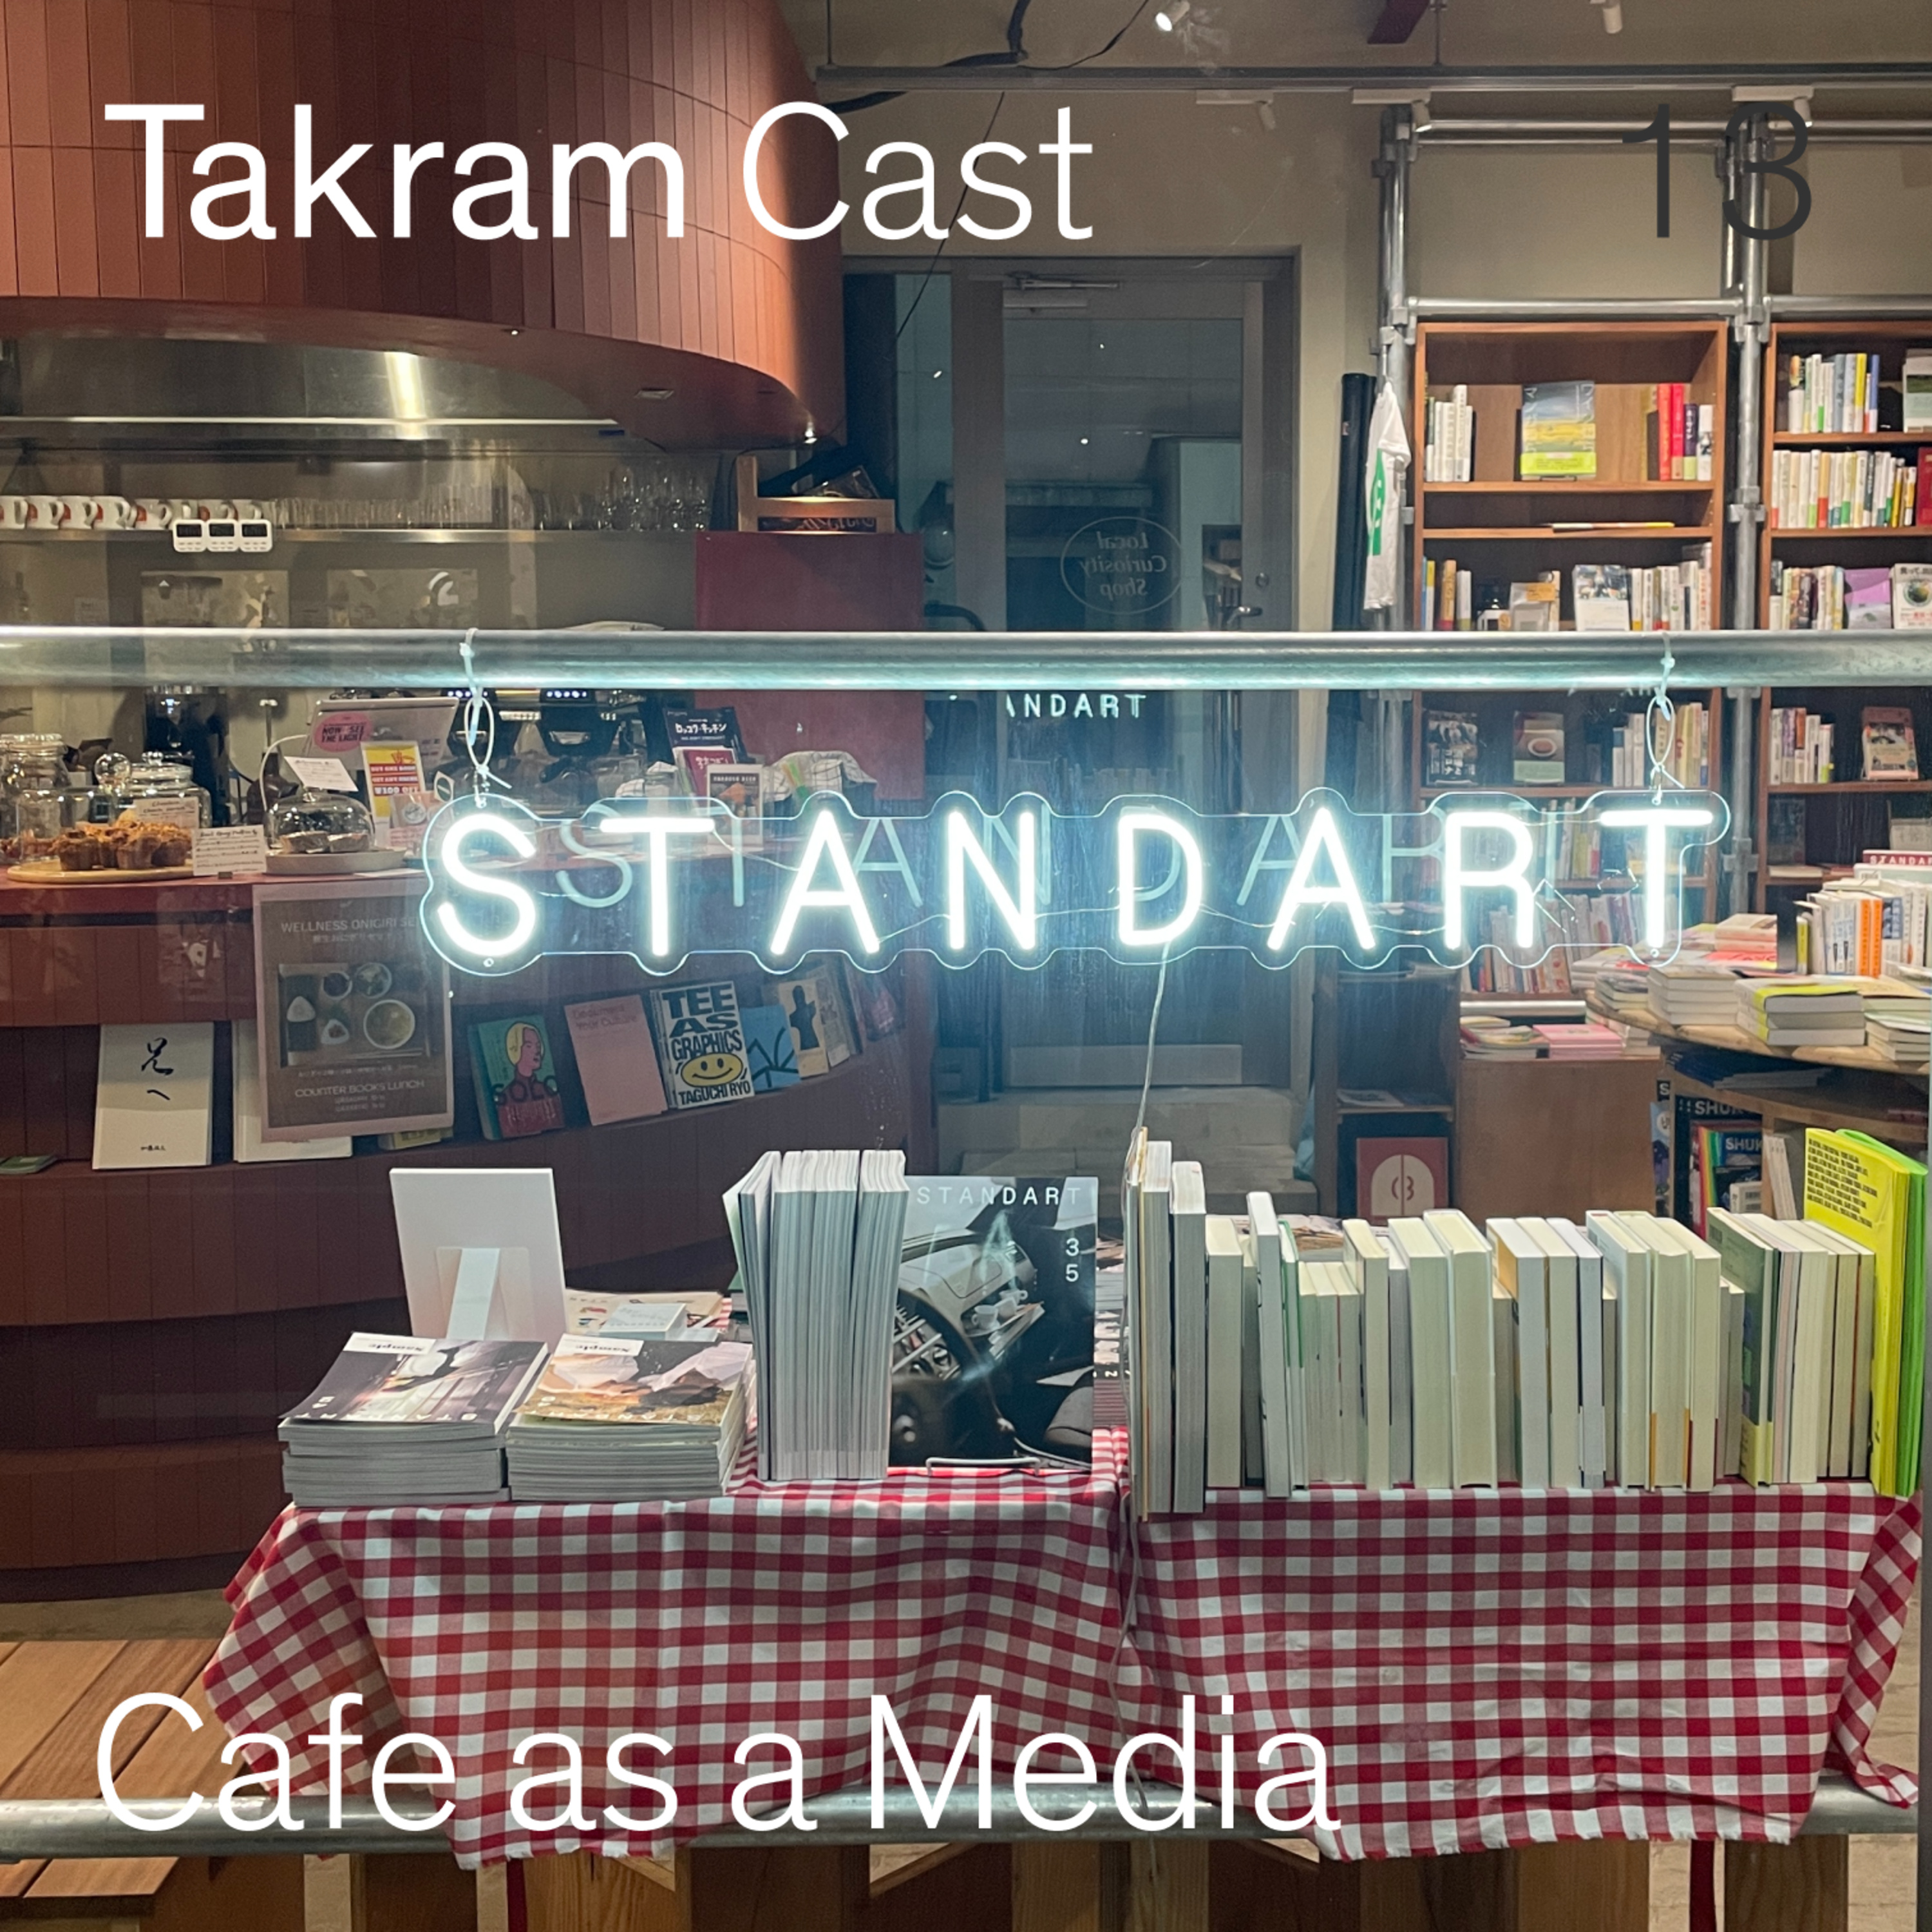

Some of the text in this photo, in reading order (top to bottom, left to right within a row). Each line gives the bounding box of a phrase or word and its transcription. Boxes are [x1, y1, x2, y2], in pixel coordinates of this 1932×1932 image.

[435, 807, 1714, 958] STANDART
[281, 920, 348, 933] WELLNESS
[351, 917, 397, 931] ONIGIRI
[661, 984, 735, 1019] TEE
[669, 1012, 739, 1039] AS
[671, 1029, 743, 1061] GRAPHICS
[348, 1082, 386, 1094] BOOKS
[387, 1079, 425, 1091] LUNCH
[678, 1081, 751, 1106] TAGUCHI RYO
[916, 1186, 1081, 1205] STANDART
